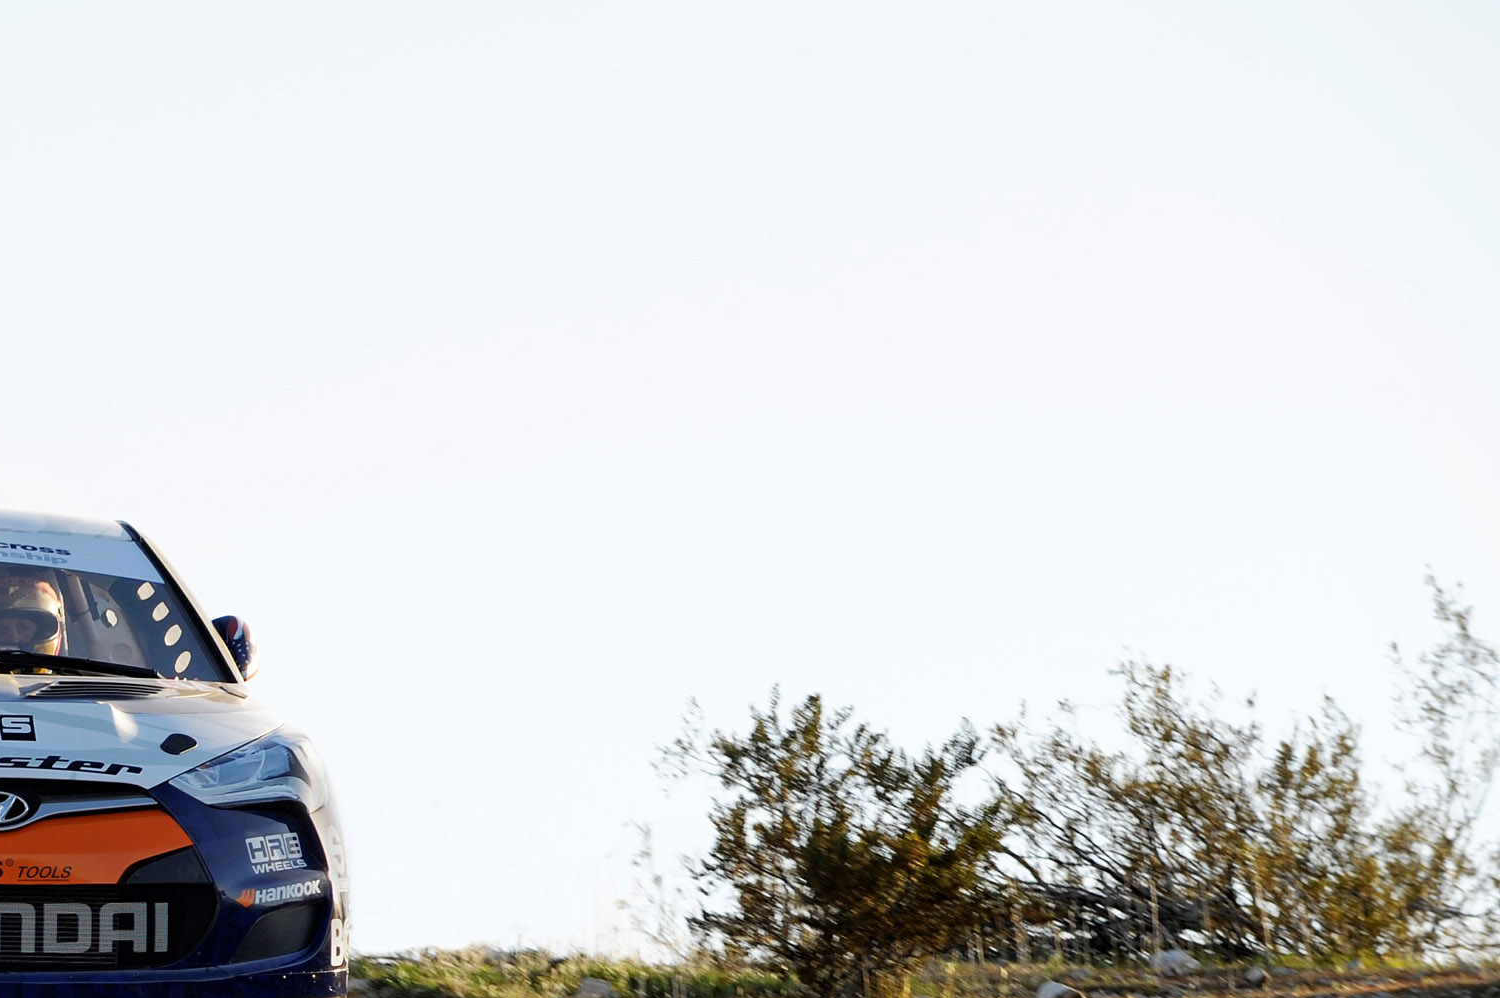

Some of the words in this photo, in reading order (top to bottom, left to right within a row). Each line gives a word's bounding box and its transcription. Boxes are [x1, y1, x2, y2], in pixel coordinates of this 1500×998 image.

[245, 832, 303, 864] HRE
[17, 865, 72, 879] TOOLS
[251, 859, 308, 875] WHEELS
